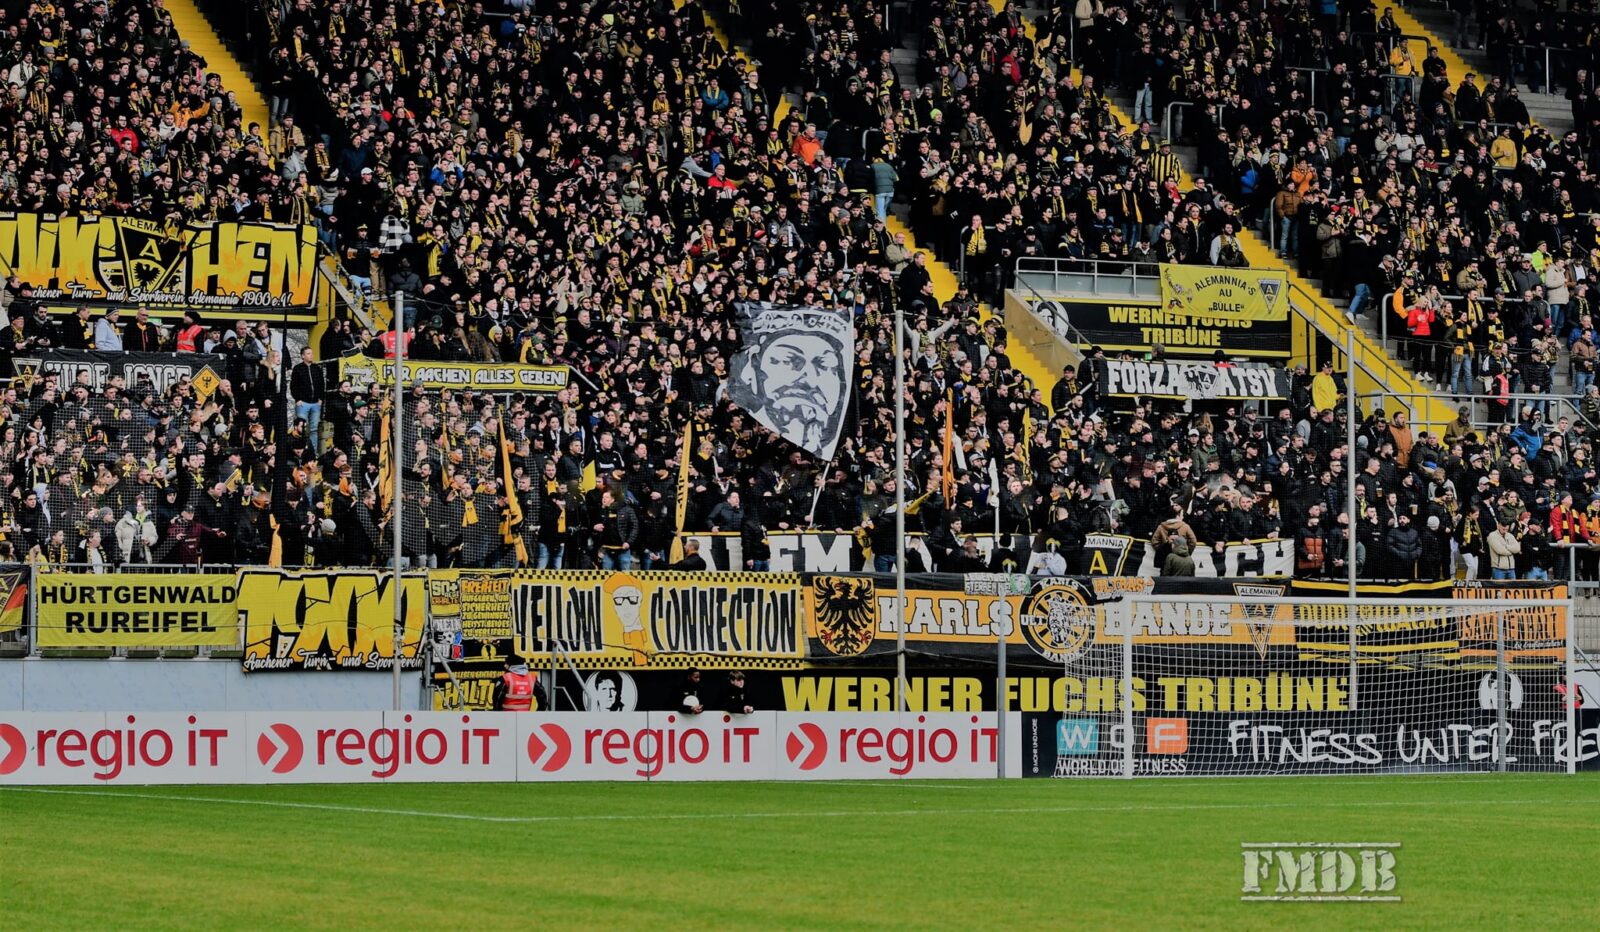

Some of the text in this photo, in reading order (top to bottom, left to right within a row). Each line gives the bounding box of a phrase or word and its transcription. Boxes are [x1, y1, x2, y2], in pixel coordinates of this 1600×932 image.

[107, 288, 126, 301] und
[242, 291, 271, 306] 1900
[1219, 288, 1232, 297] AU
[1108, 306, 1187, 326] WERNER
[1140, 326, 1221, 346] TRIBÜNE
[415, 366, 471, 383] AACHEN
[475, 368, 514, 384] ALLES
[519, 370, 566, 386] GEBEN!
[1108, 361, 1279, 397] FORZA ATSV
[1089, 551, 1108, 574] A
[41, 582, 236, 604] HÜRTGENWALD
[462, 579, 509, 593] FREIHEIT
[1240, 587, 1280, 595] ALEMANNIA
[463, 602, 509, 611] SICHERHEIT
[877, 597, 1233, 637] KARLS BANDE
[66, 612, 216, 633] RUREIFEL
[514, 585, 797, 653] YELLOW CONNECTION
[244, 652, 293, 671] Aachener
[342, 654, 363, 667] und
[365, 651, 423, 671] Sporerein
[782, 672, 1348, 712] WERNER FUCHS TRIBÜNE
[37, 715, 174, 780] regio
[317, 714, 448, 778] regio
[585, 715, 709, 777] regio
[840, 715, 957, 775] regio
[1228, 720, 1600, 765] FITNESS UNTER FRE
[1059, 759, 1106, 774] WORLD
[1132, 758, 1192, 773] FITNESS
